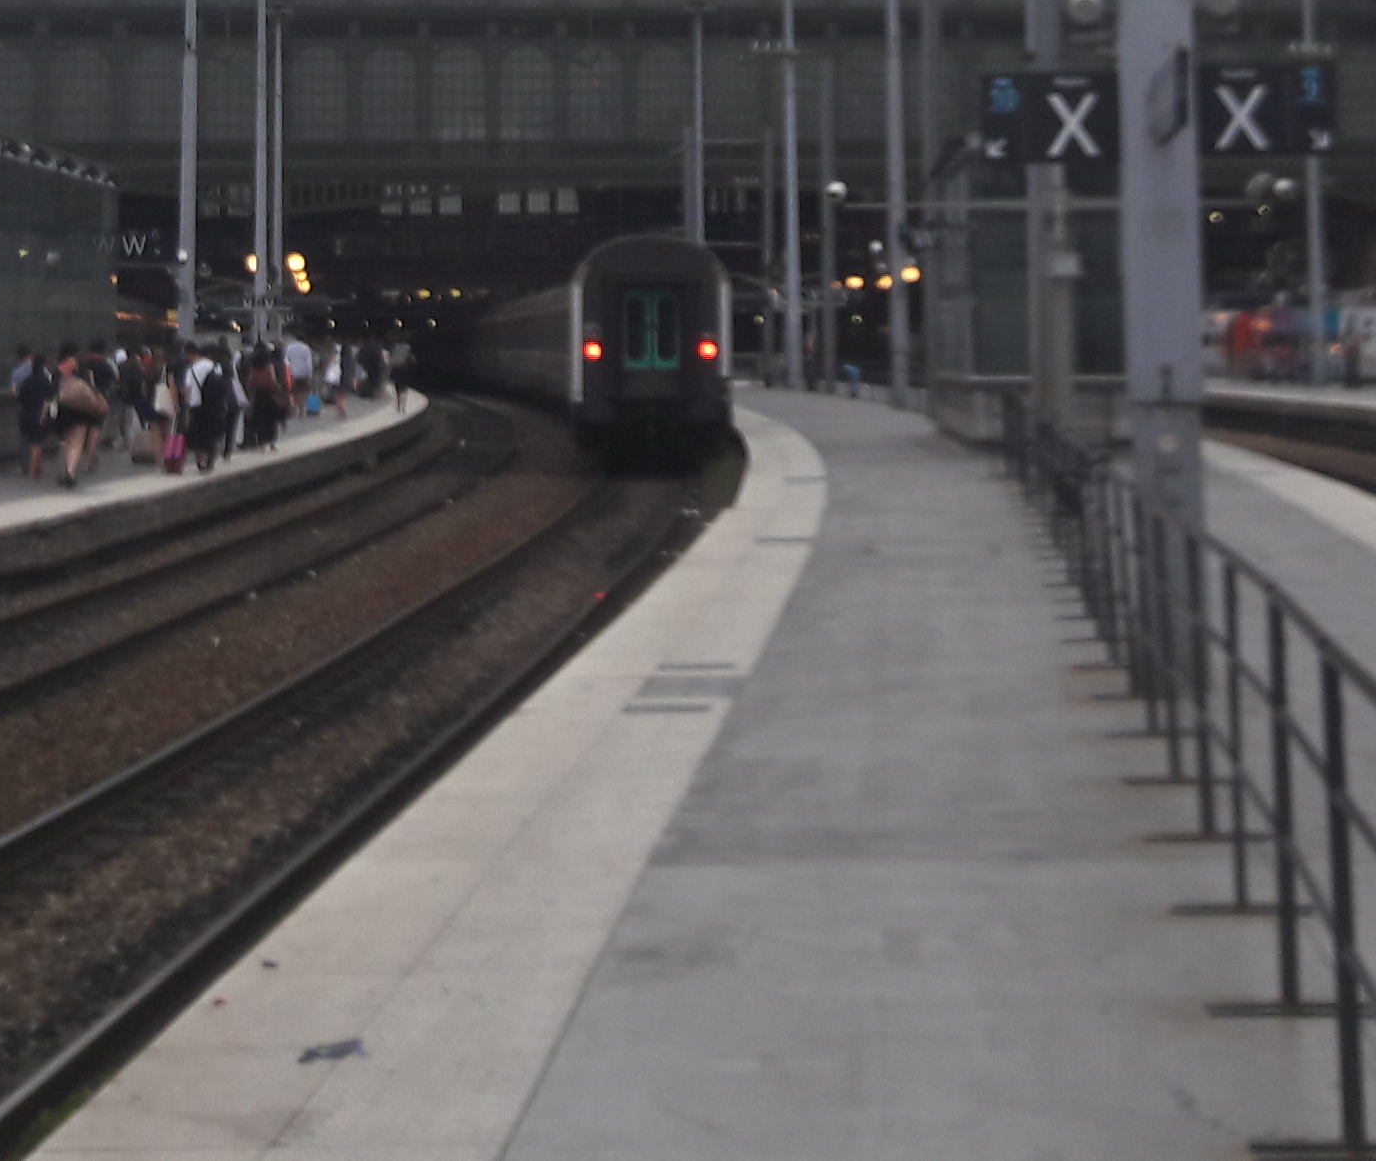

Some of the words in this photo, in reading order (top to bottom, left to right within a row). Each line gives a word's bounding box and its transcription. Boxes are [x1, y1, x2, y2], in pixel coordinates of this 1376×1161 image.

[1046, 92, 1101, 158] X
[1213, 84, 1269, 152] X
[122, 233, 148, 256] W
